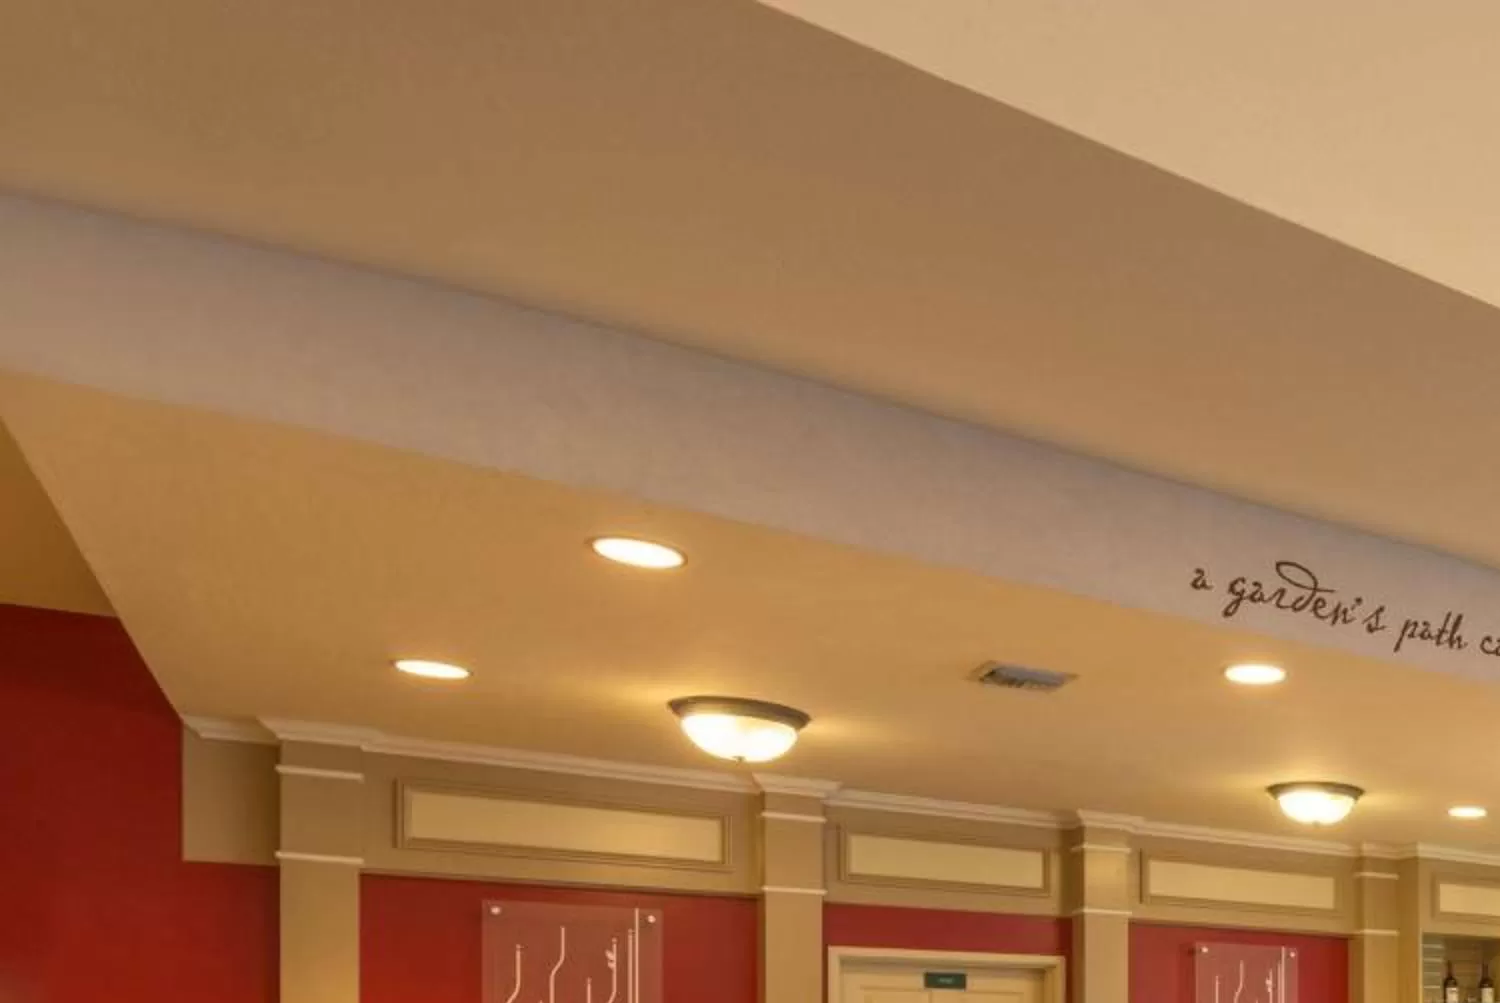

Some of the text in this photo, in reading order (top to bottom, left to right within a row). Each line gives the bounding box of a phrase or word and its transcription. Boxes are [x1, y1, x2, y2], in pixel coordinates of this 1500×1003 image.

[1190, 567, 1213, 590] a
[1222, 561, 1387, 634] garden's
[1393, 612, 1468, 653] path
